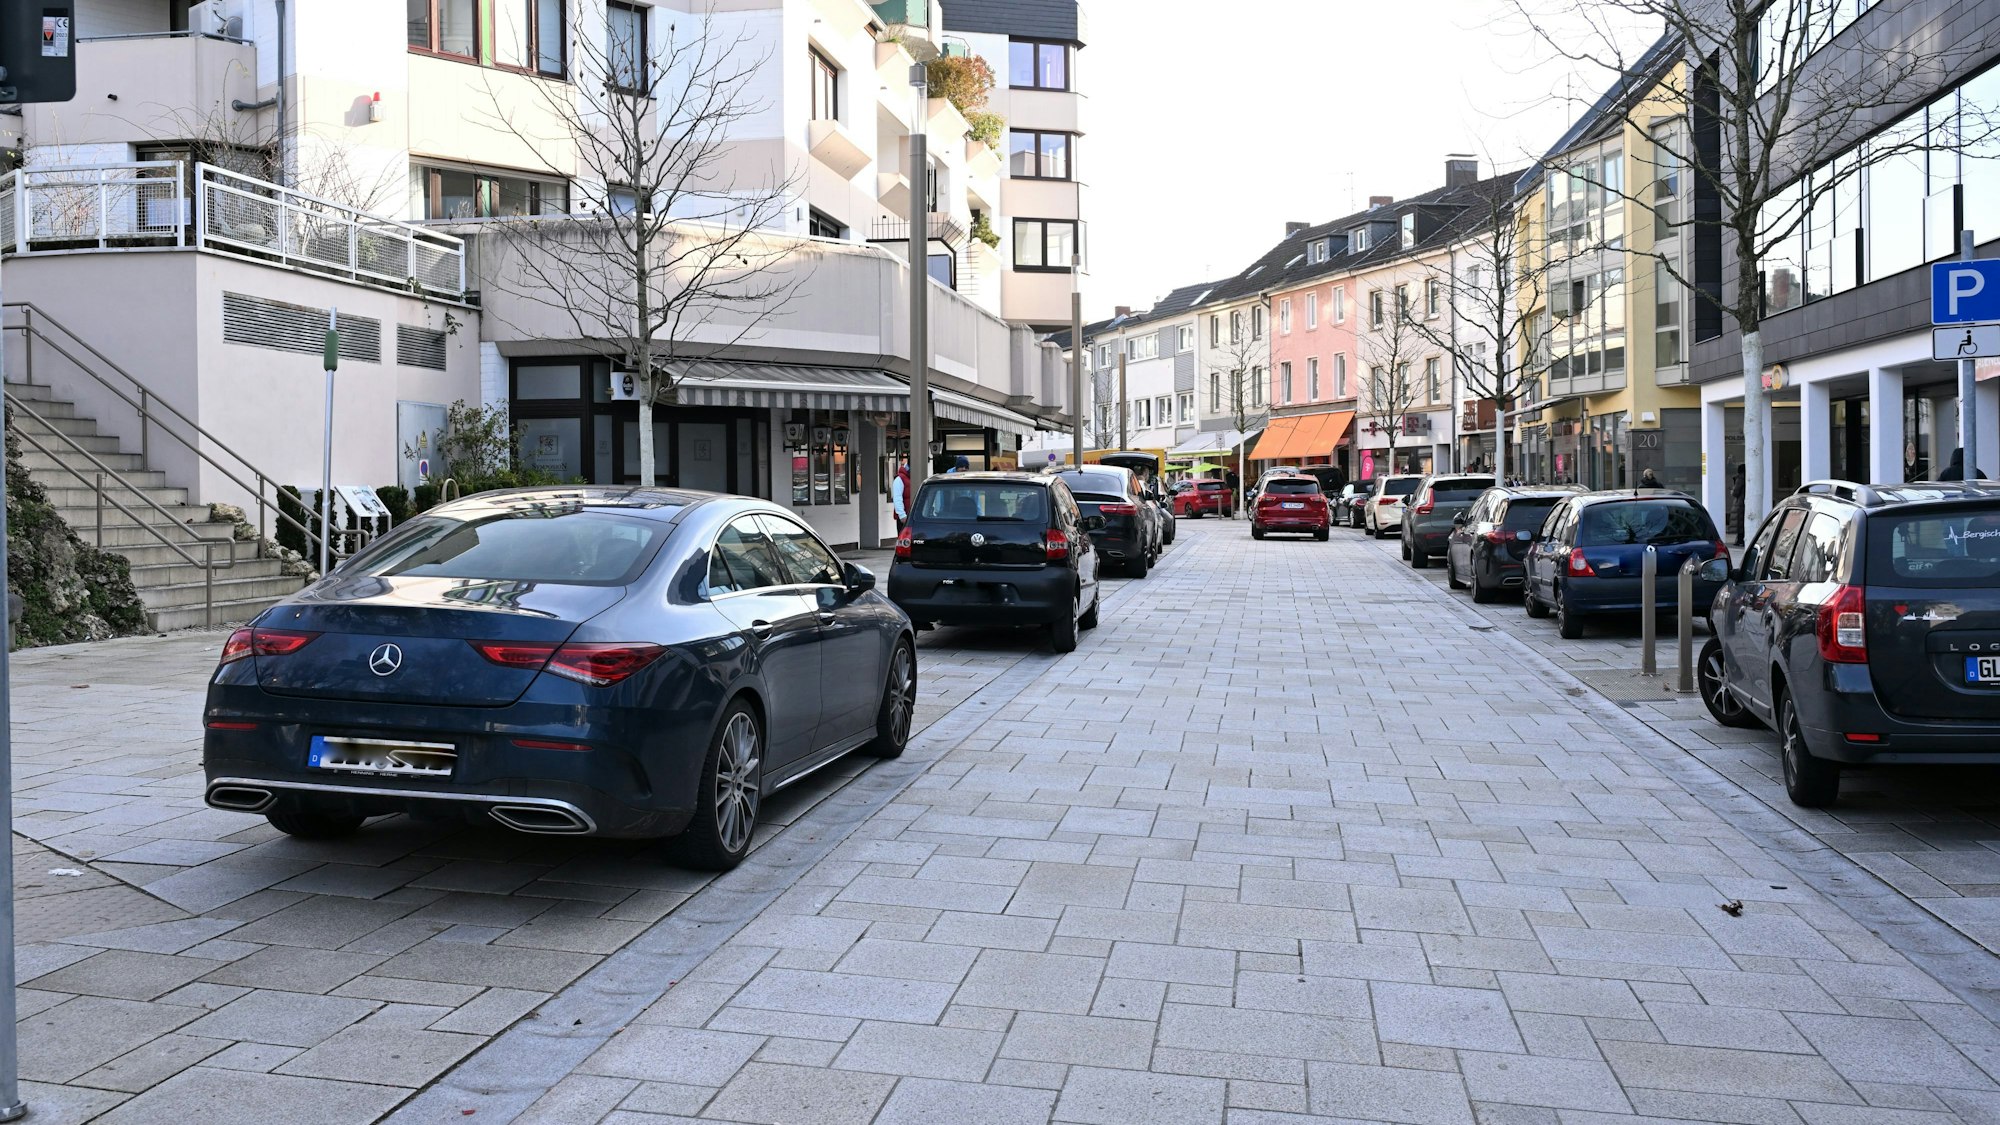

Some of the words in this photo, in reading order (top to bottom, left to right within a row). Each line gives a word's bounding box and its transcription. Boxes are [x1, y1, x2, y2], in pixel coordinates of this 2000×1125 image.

[1948, 269, 1985, 315] P
[1638, 433, 1658, 448] 20
[1950, 643, 2000, 651] LOG
[1979, 659, 2000, 679] GL
